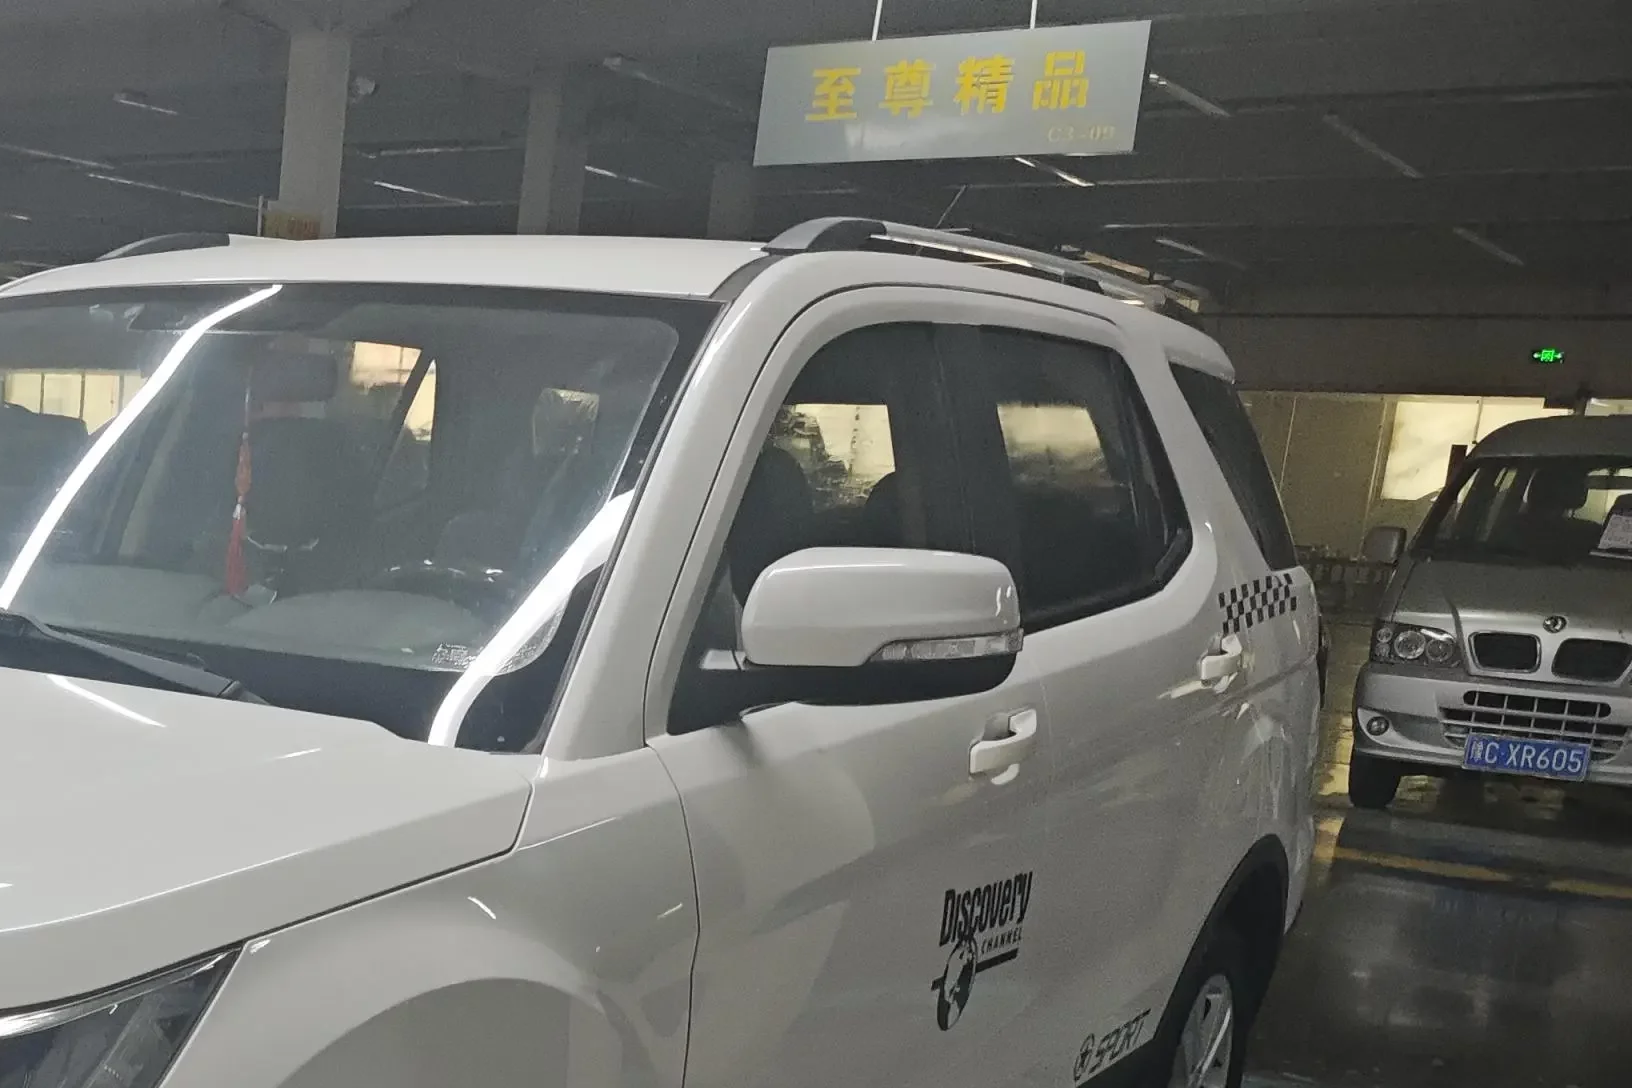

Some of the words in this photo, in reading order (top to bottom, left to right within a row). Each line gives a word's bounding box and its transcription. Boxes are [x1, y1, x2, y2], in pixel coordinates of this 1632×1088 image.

[805, 48, 1090, 122] 至尊精品
[980, 926, 1024, 955] CHANNEL
[1087, 1007, 1152, 1075] SPORT
